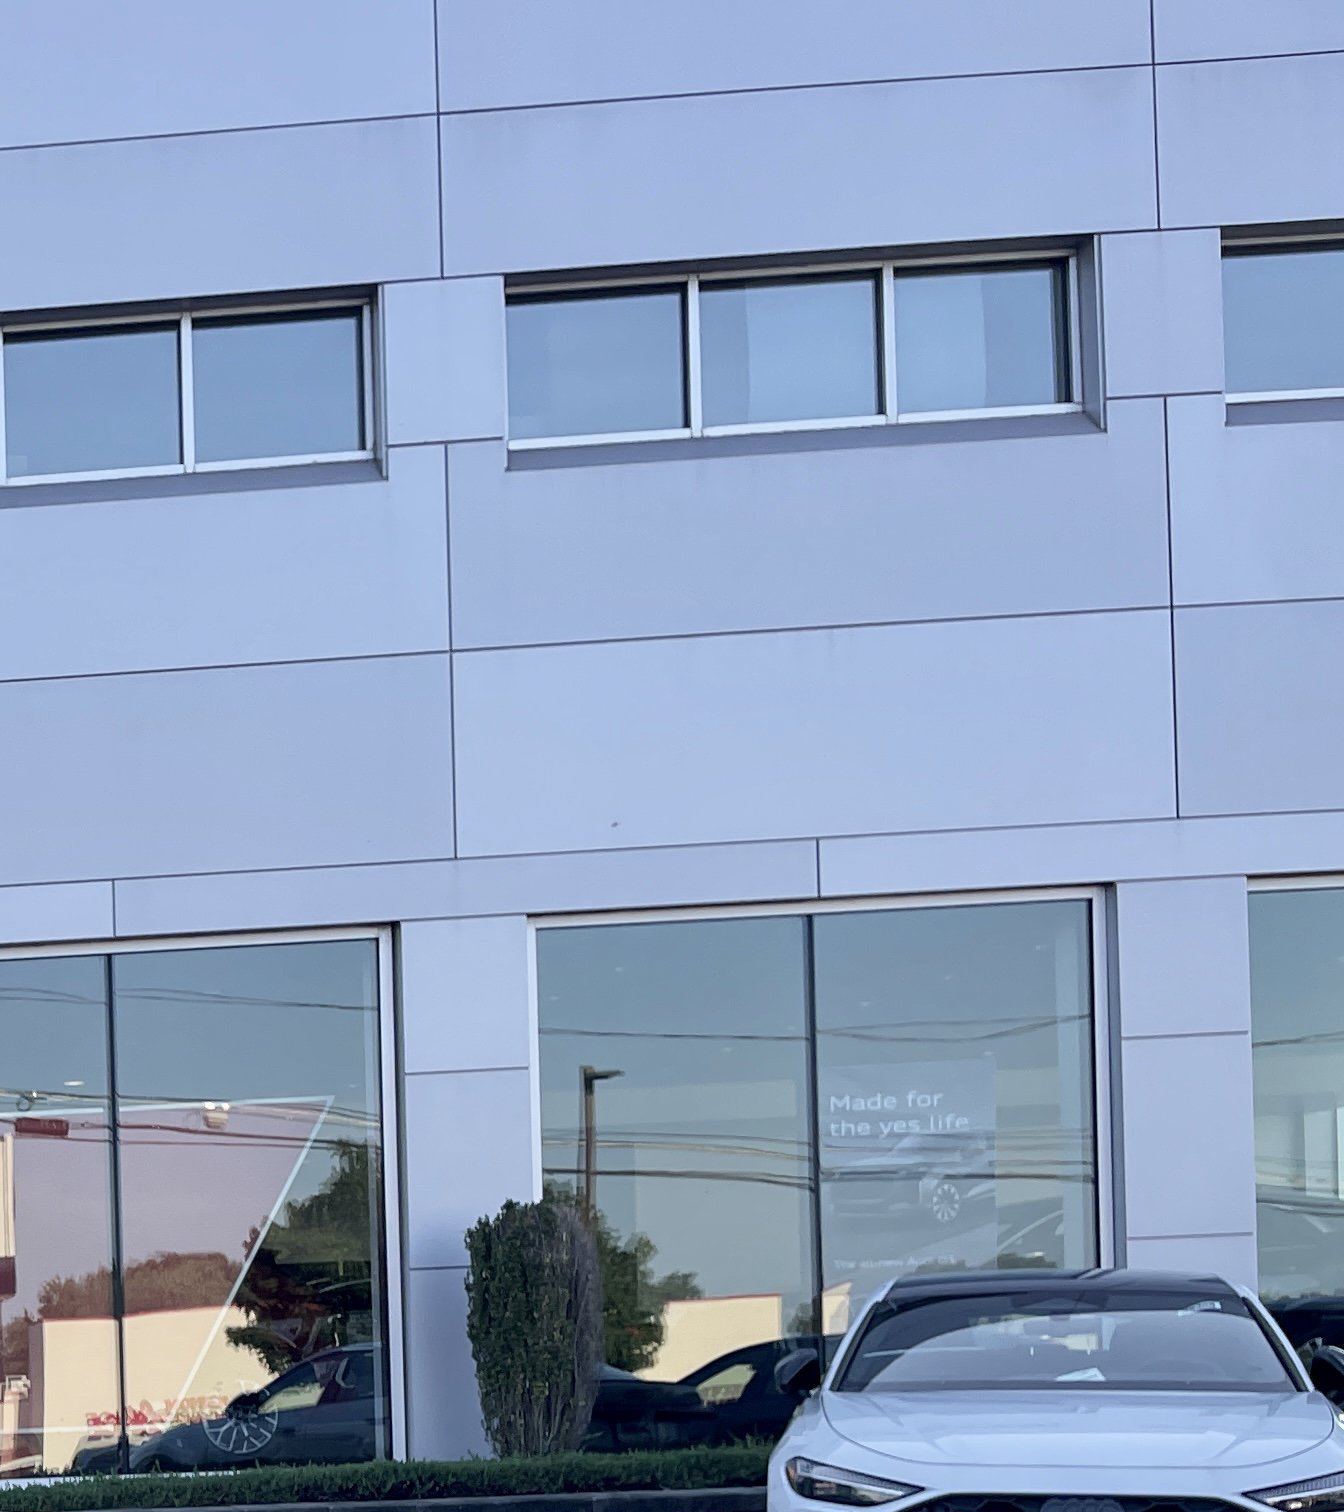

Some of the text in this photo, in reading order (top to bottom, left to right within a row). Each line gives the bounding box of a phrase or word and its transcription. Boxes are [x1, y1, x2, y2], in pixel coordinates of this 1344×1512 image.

[829, 1090, 943, 1112] Made for
[830, 1113, 969, 1139] the yes life
